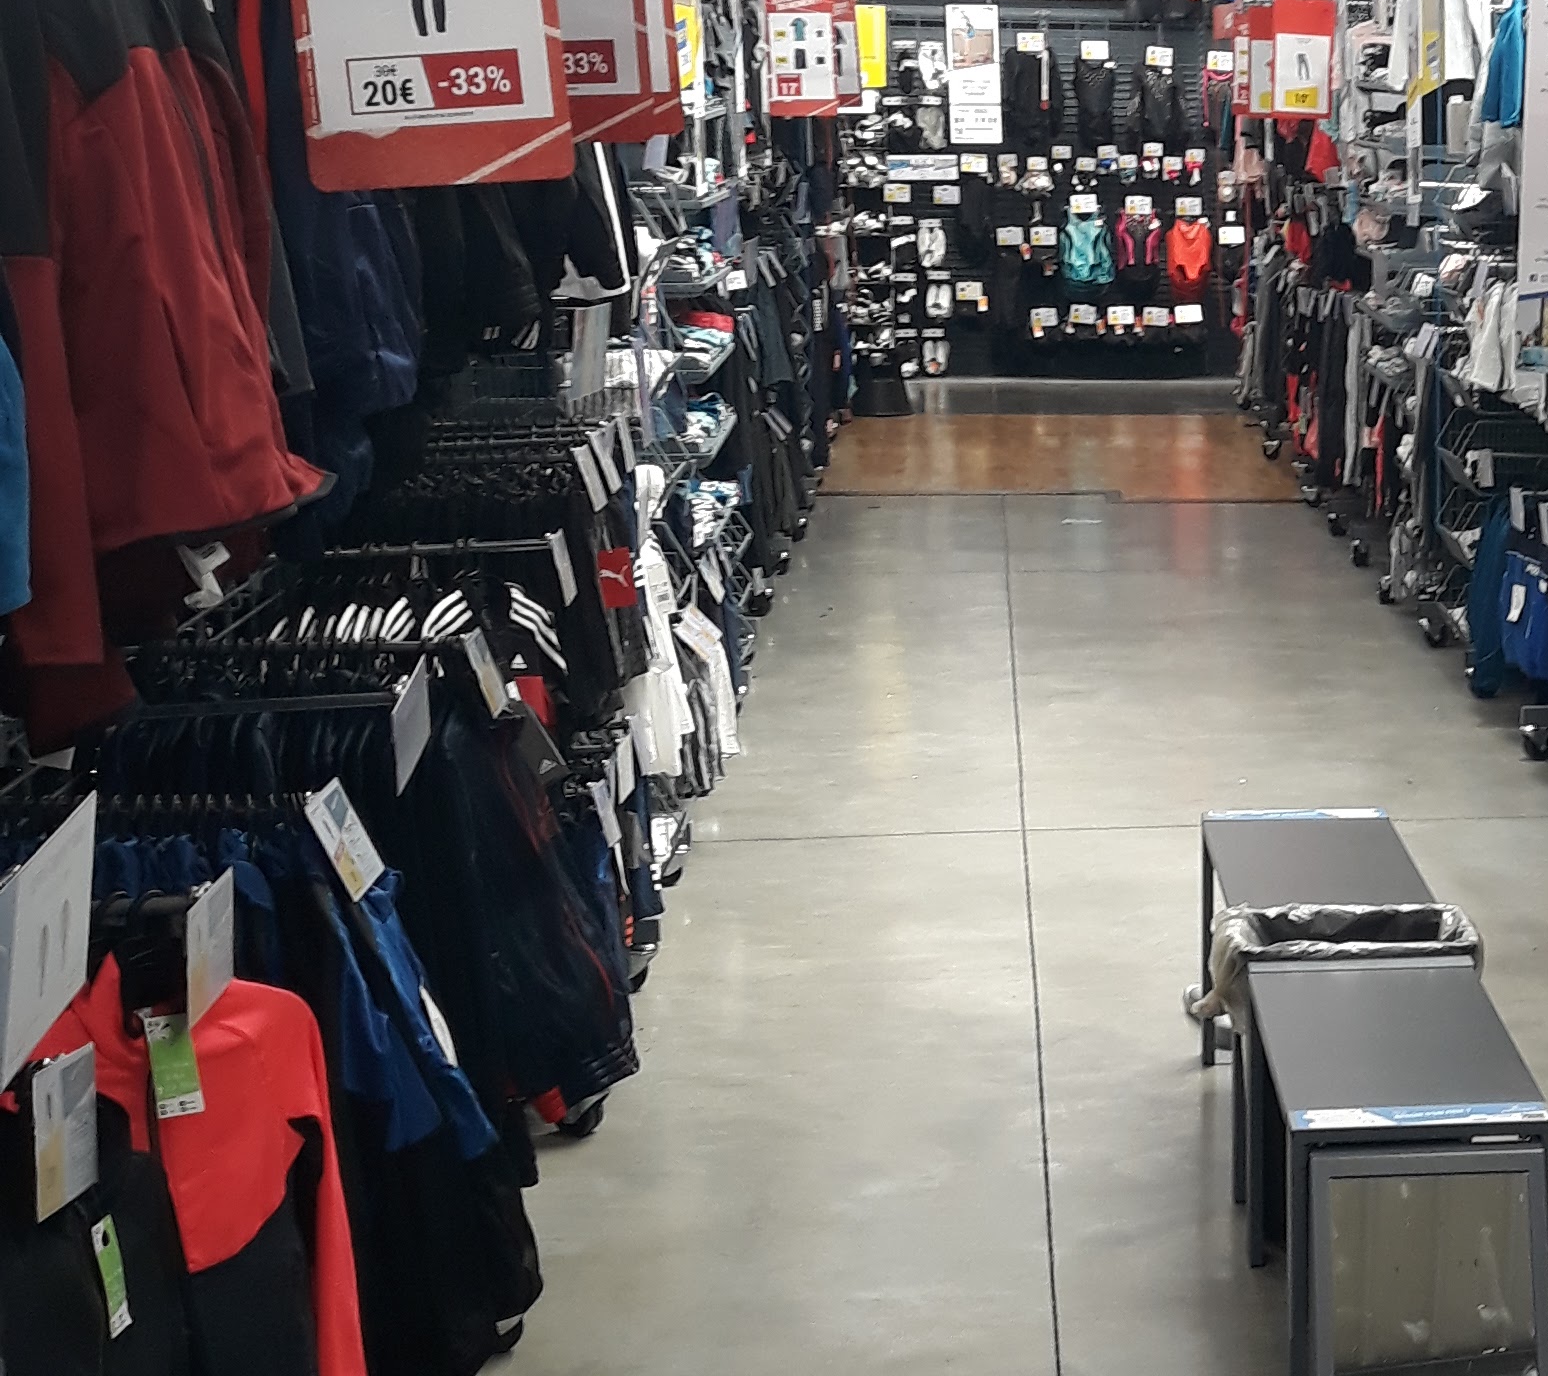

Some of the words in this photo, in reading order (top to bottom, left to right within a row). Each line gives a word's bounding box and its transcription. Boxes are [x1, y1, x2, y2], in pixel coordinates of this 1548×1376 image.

[562, 52, 608, 74] 33%
[362, 78, 416, 107] 20€
[437, 65, 511, 96] -33%
